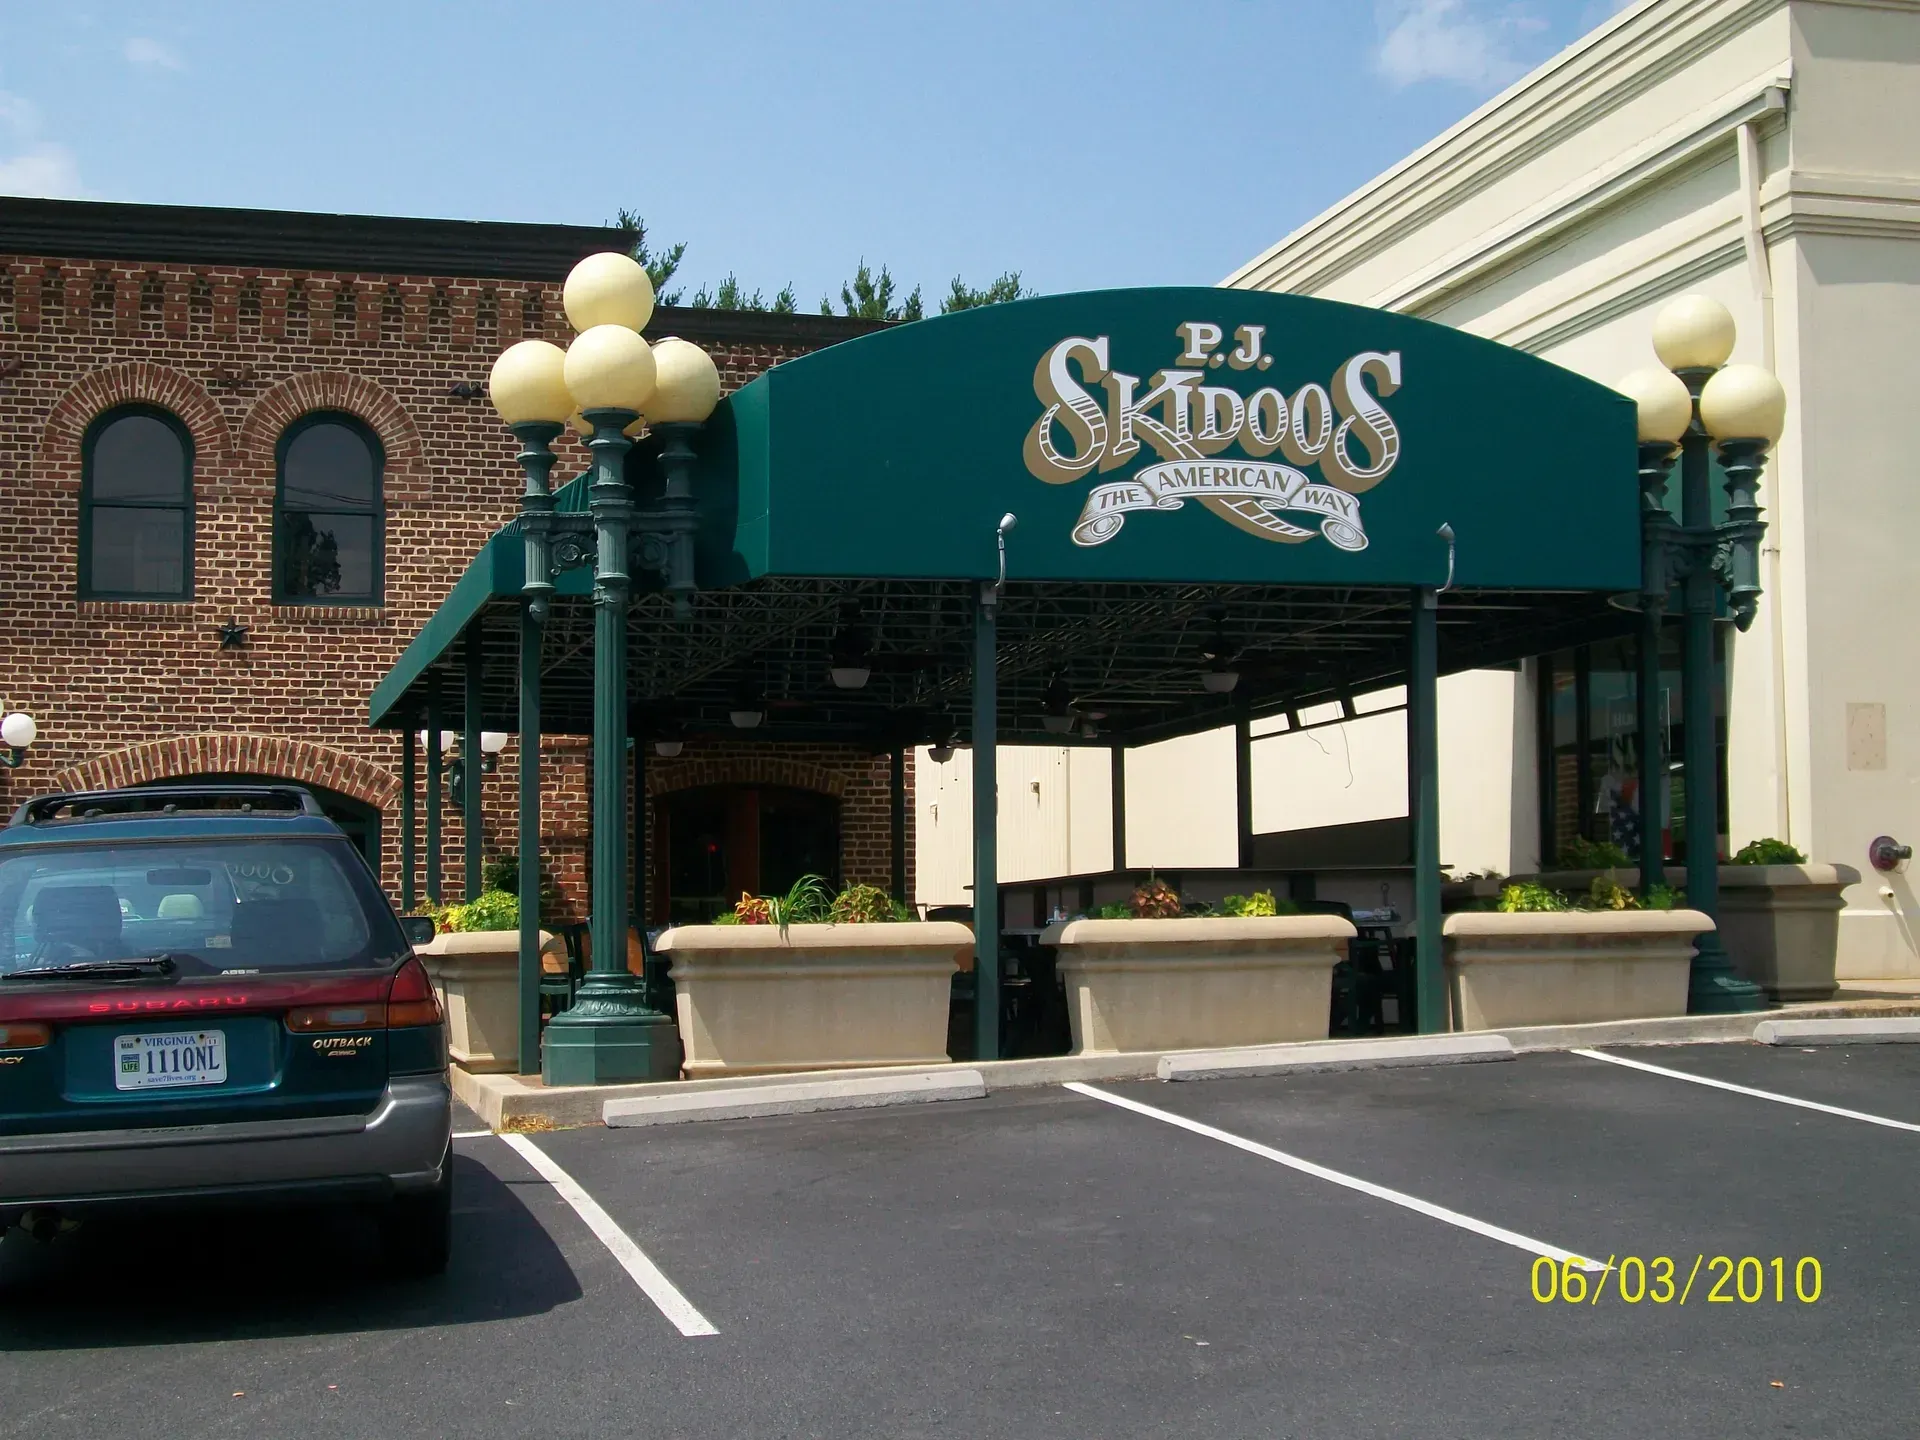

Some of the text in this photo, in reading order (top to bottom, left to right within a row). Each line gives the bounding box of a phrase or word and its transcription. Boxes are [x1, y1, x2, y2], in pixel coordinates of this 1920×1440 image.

[1180, 321, 1275, 368] P.J.
[1098, 466, 1354, 516] THE AMERICAN WAY
[89, 997, 247, 1012] SUBARU
[144, 1035, 196, 1047] VIRGINIA
[312, 1036, 372, 1049] OUTBACK
[123, 1062, 138, 1071] LIFE
[146, 1046, 220, 1075] 1110NL
[147, 1074, 197, 1083] save7lives.org
